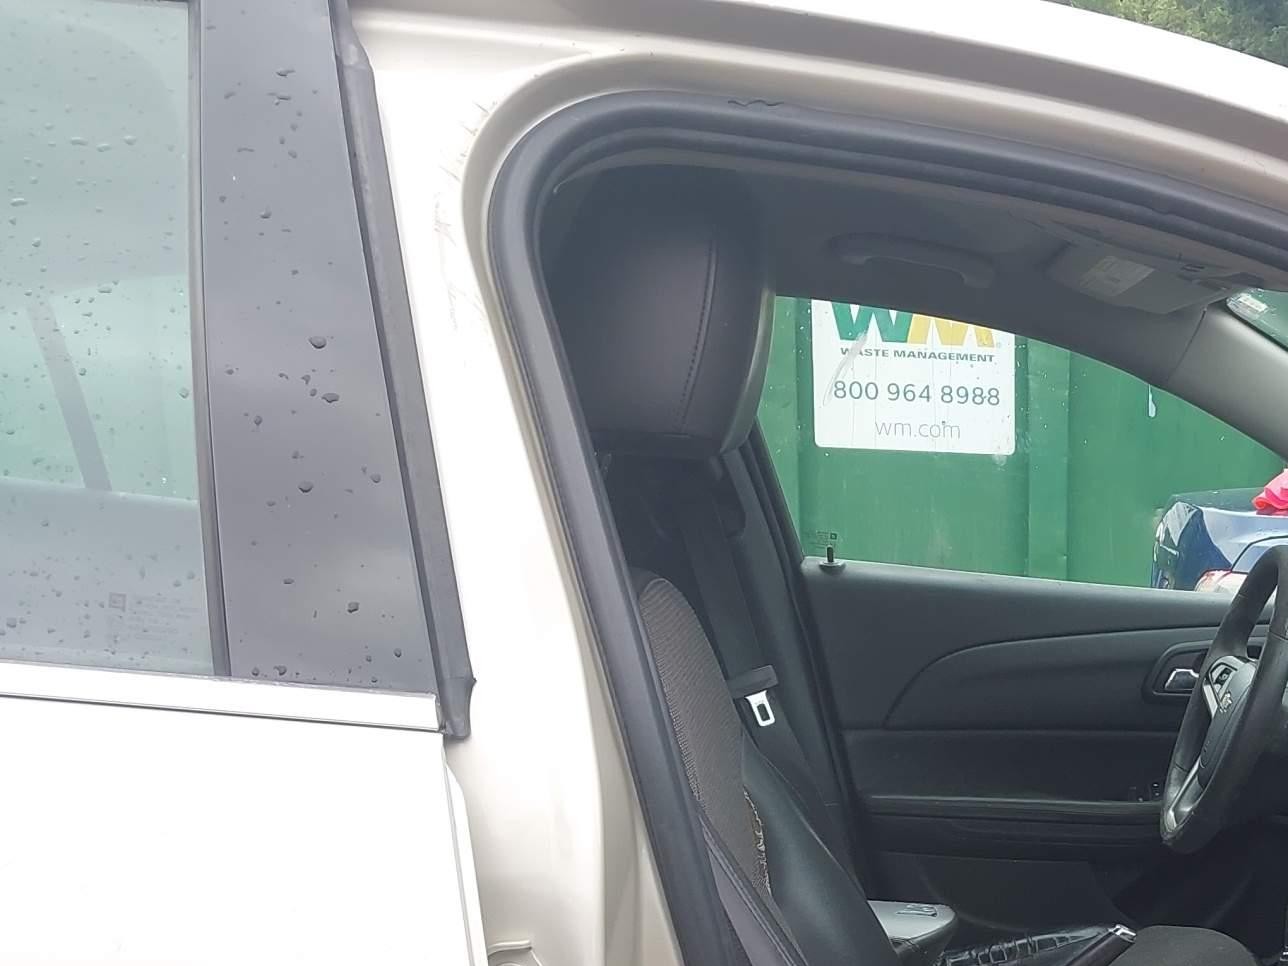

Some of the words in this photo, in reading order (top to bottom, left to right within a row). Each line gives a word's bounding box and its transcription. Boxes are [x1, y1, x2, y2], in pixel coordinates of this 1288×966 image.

[893, 350, 995, 363] MANAGEMENT
[833, 380, 880, 401] 800
[886, 383, 932, 403] 964
[940, 384, 1001, 406] 8988
[874, 420, 961, 439] wm.com
